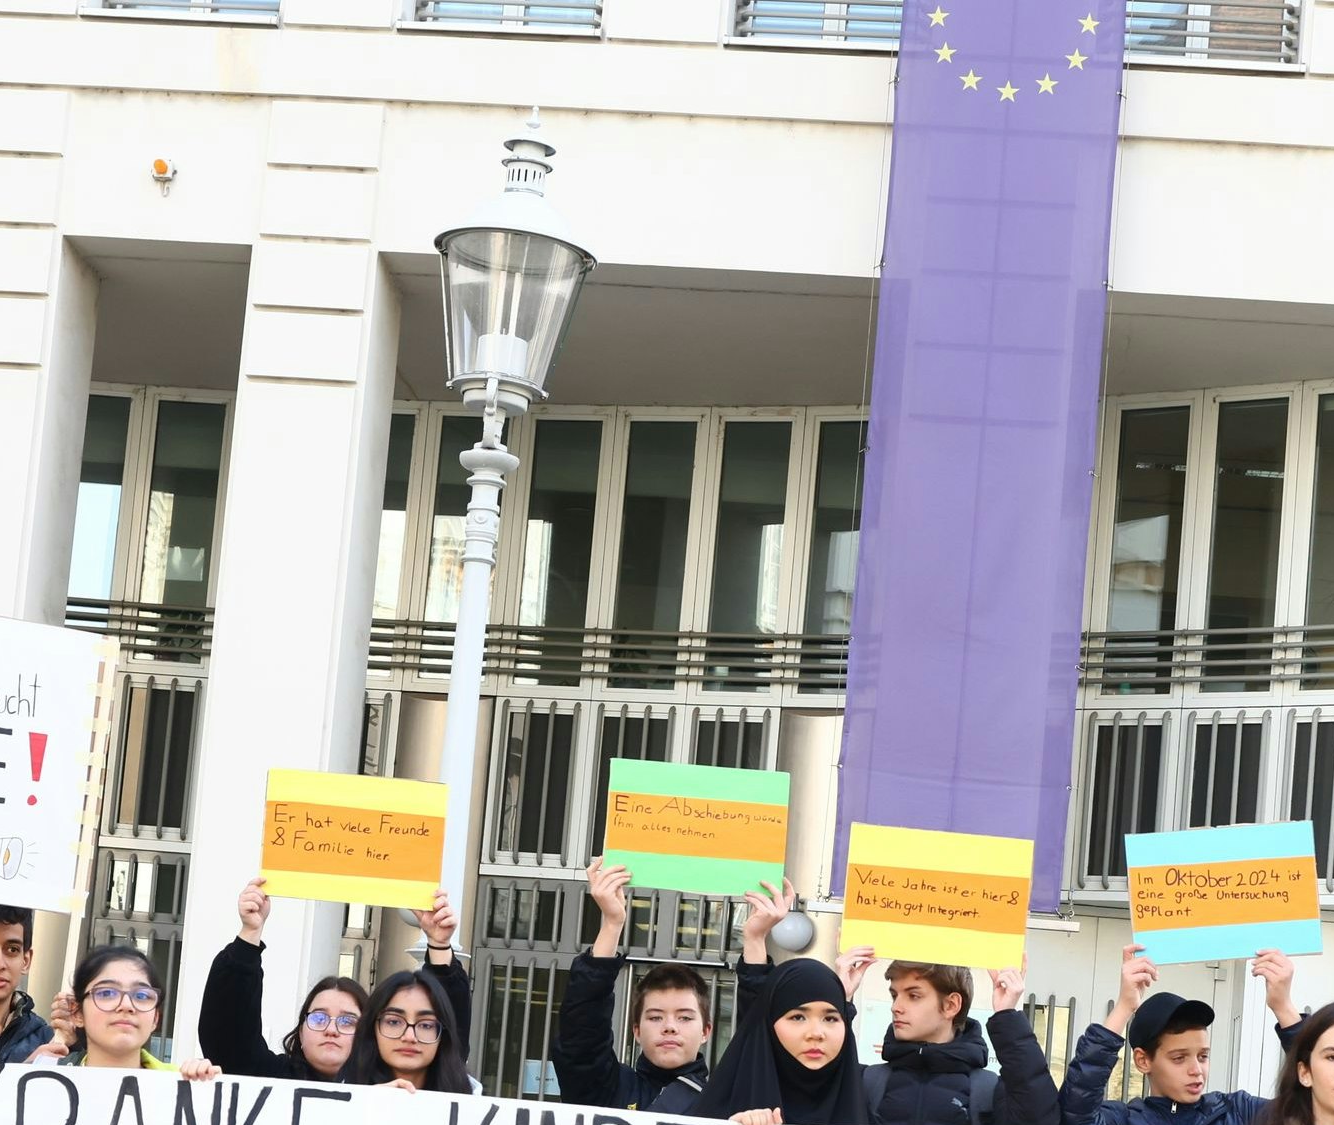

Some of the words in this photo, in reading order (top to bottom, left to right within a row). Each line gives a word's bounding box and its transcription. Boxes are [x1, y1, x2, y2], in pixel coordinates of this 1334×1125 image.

[274, 803, 296, 823] Er
[306, 811, 333, 829] hat
[340, 821, 372, 835] viele
[380, 814, 430, 837] Freunde
[615, 794, 652, 815] Eine
[657, 797, 750, 825] Abschiebung
[292, 831, 355, 856] Familie
[641, 823, 671, 834] alles
[676, 826, 715, 839] nehmen
[854, 867, 895, 887] Viele
[902, 878, 937, 893] Jahre
[942, 882, 959, 894] ist
[960, 889, 977, 898] er
[982, 888, 1007, 902] hier
[1137, 873, 1154, 885] Im
[1165, 868, 1232, 888] Oktober
[1236, 869, 1281, 887] 2024
[1288, 870, 1301, 881] ist
[856, 891, 878, 906] hat
[903, 902, 923, 917] gut
[1137, 889, 1165, 900] eine
[1175, 889, 1208, 904] große
[1216, 889, 1289, 902] Untersuchung
